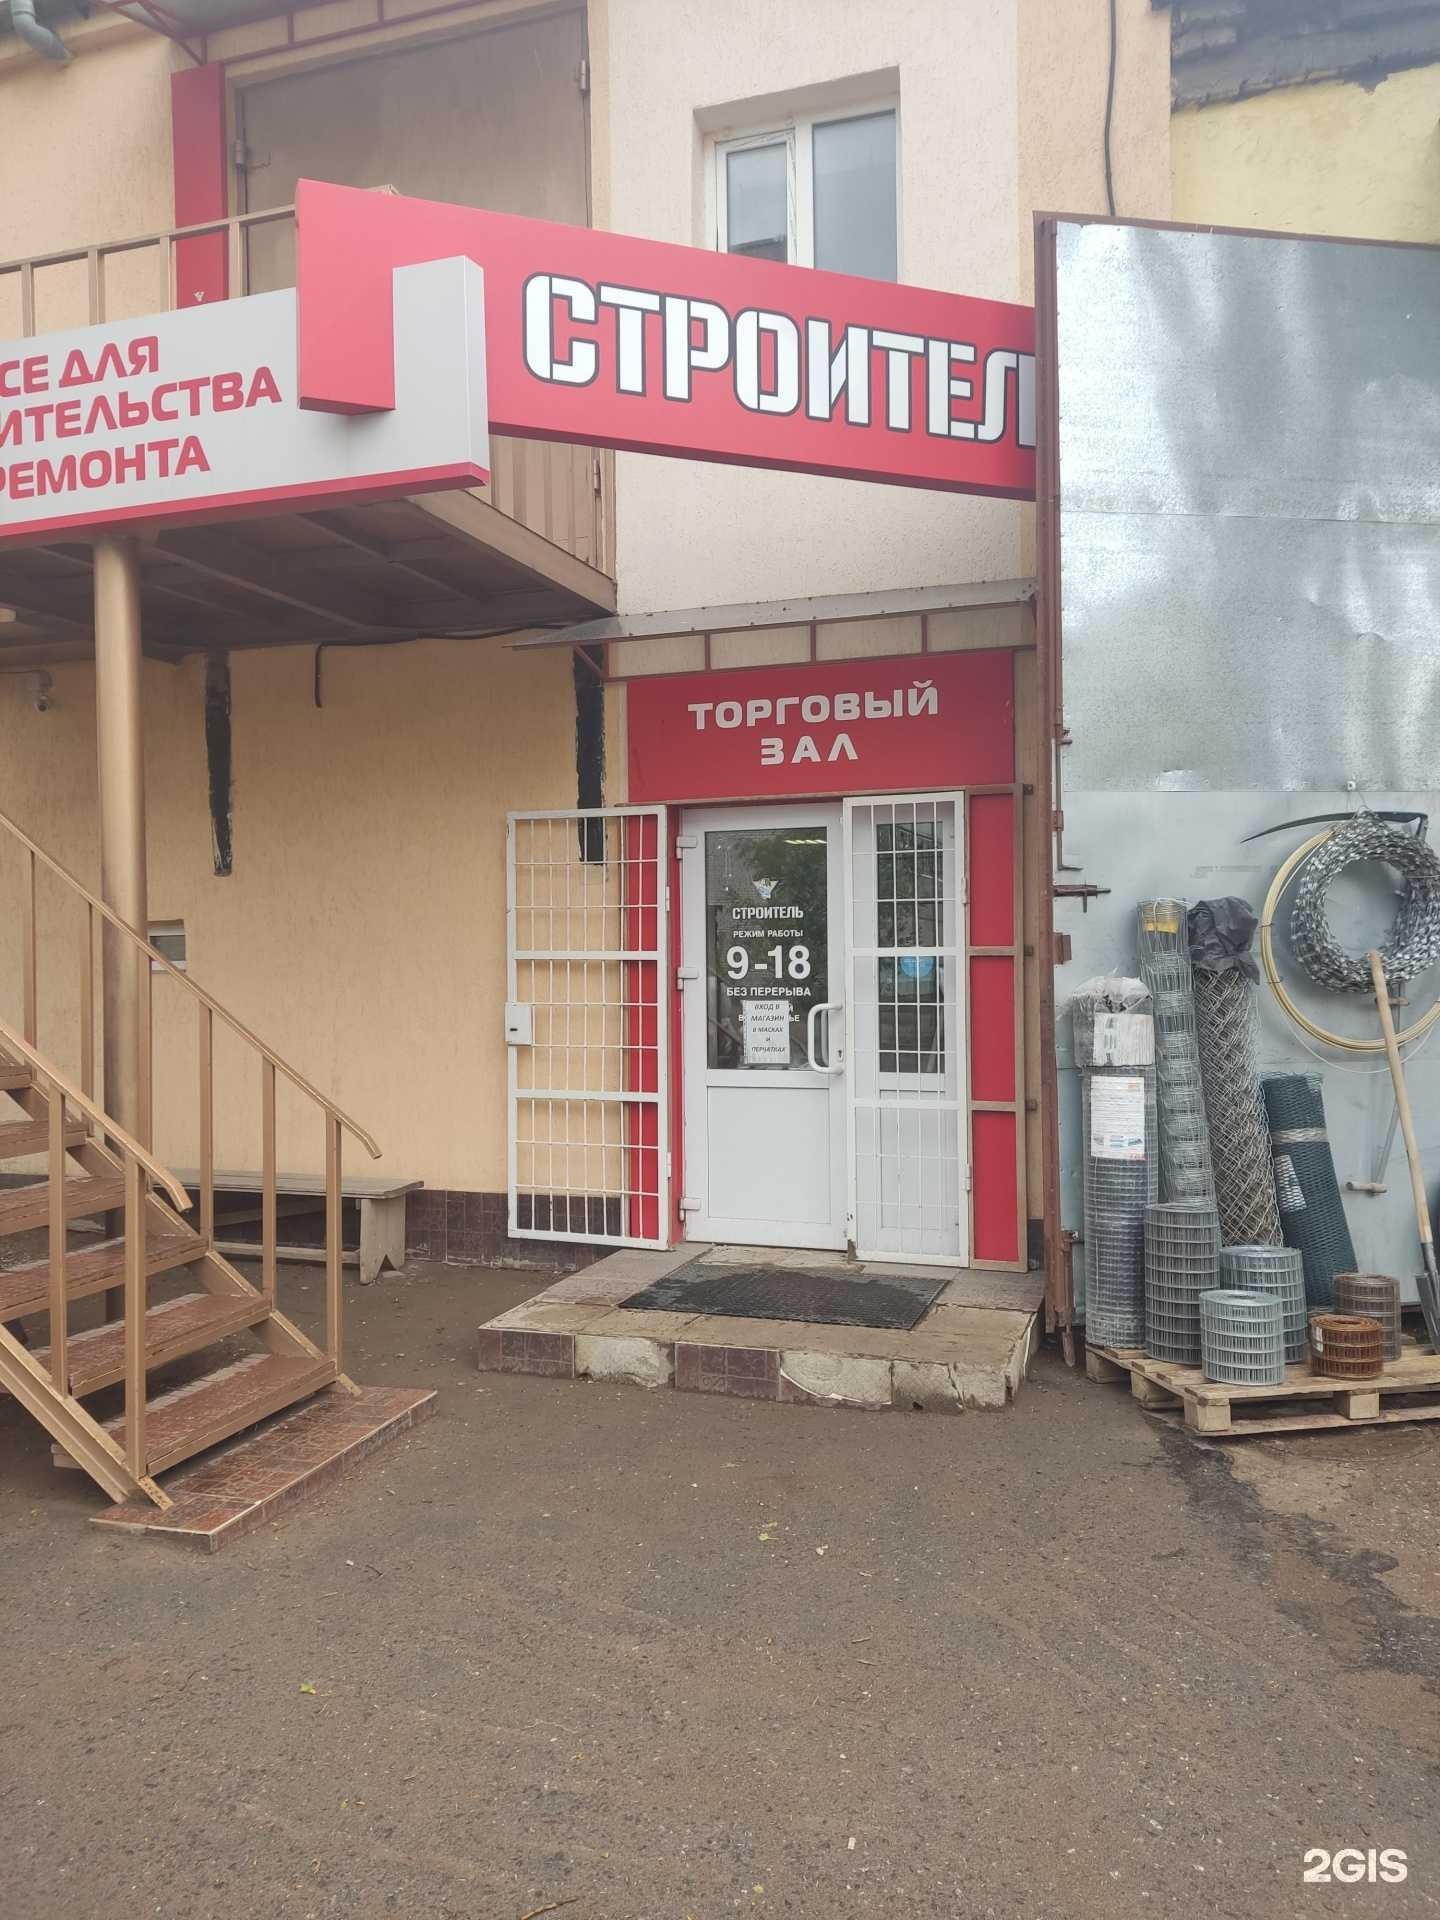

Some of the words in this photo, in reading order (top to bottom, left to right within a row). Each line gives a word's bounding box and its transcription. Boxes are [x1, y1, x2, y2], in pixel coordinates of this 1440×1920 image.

[58, 335, 160, 389] ДЛЯ
[522, 271, 1036, 449] СТРОИТЕЛ
[687, 679, 939, 730] ТОРГОВЫЙ
[760, 733, 859, 766] ЗАЛ
[732, 906, 804, 920] СТРОИТЕЛЬ
[733, 930, 765, 938] РЕЖИМ
[767, 929, 804, 937] РАБОТЫ
[726, 944, 811, 980] 9-18
[726, 986, 748, 997] БЕЗ
[750, 986, 812, 997] ПЕРЕРЫВА
